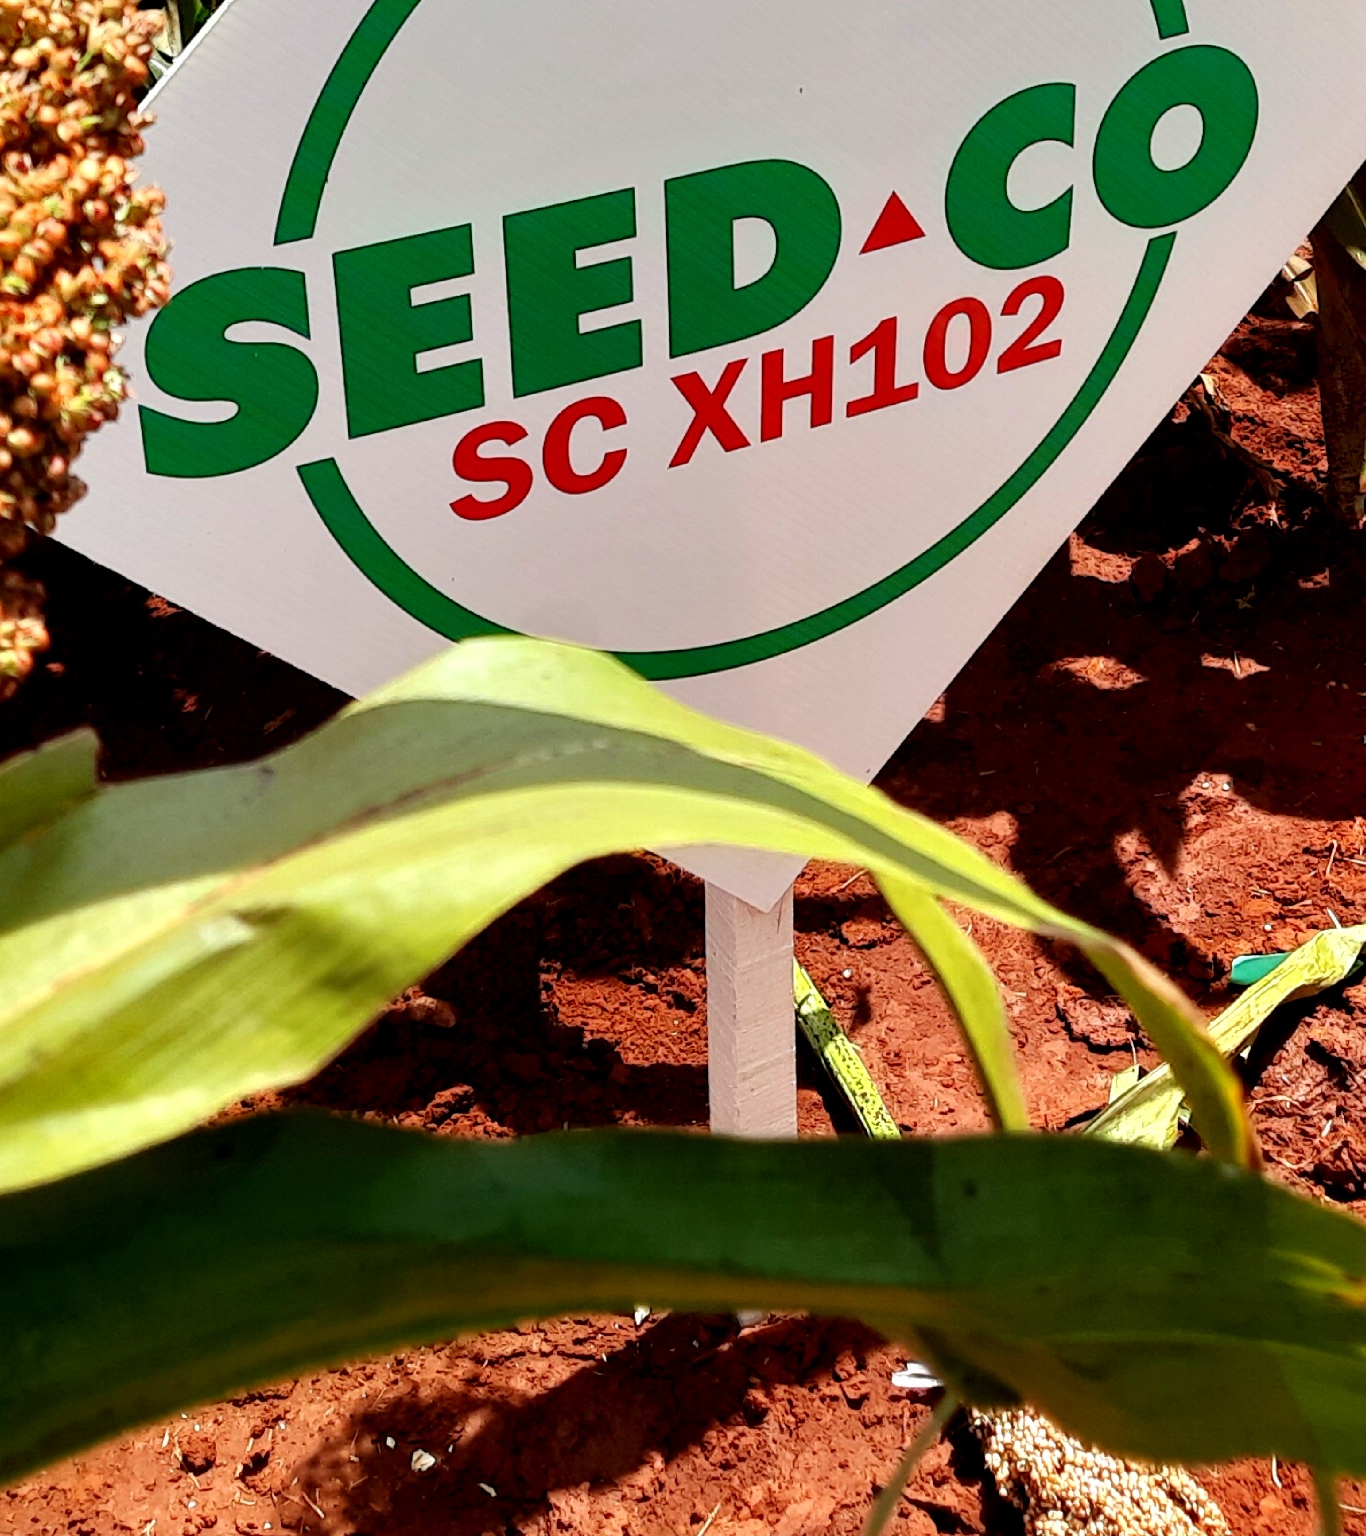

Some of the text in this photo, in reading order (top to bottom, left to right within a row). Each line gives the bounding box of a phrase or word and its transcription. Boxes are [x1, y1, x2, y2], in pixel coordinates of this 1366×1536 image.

[138, 44, 1259, 478] SEED CO
[449, 275, 1066, 521] SC XH102
